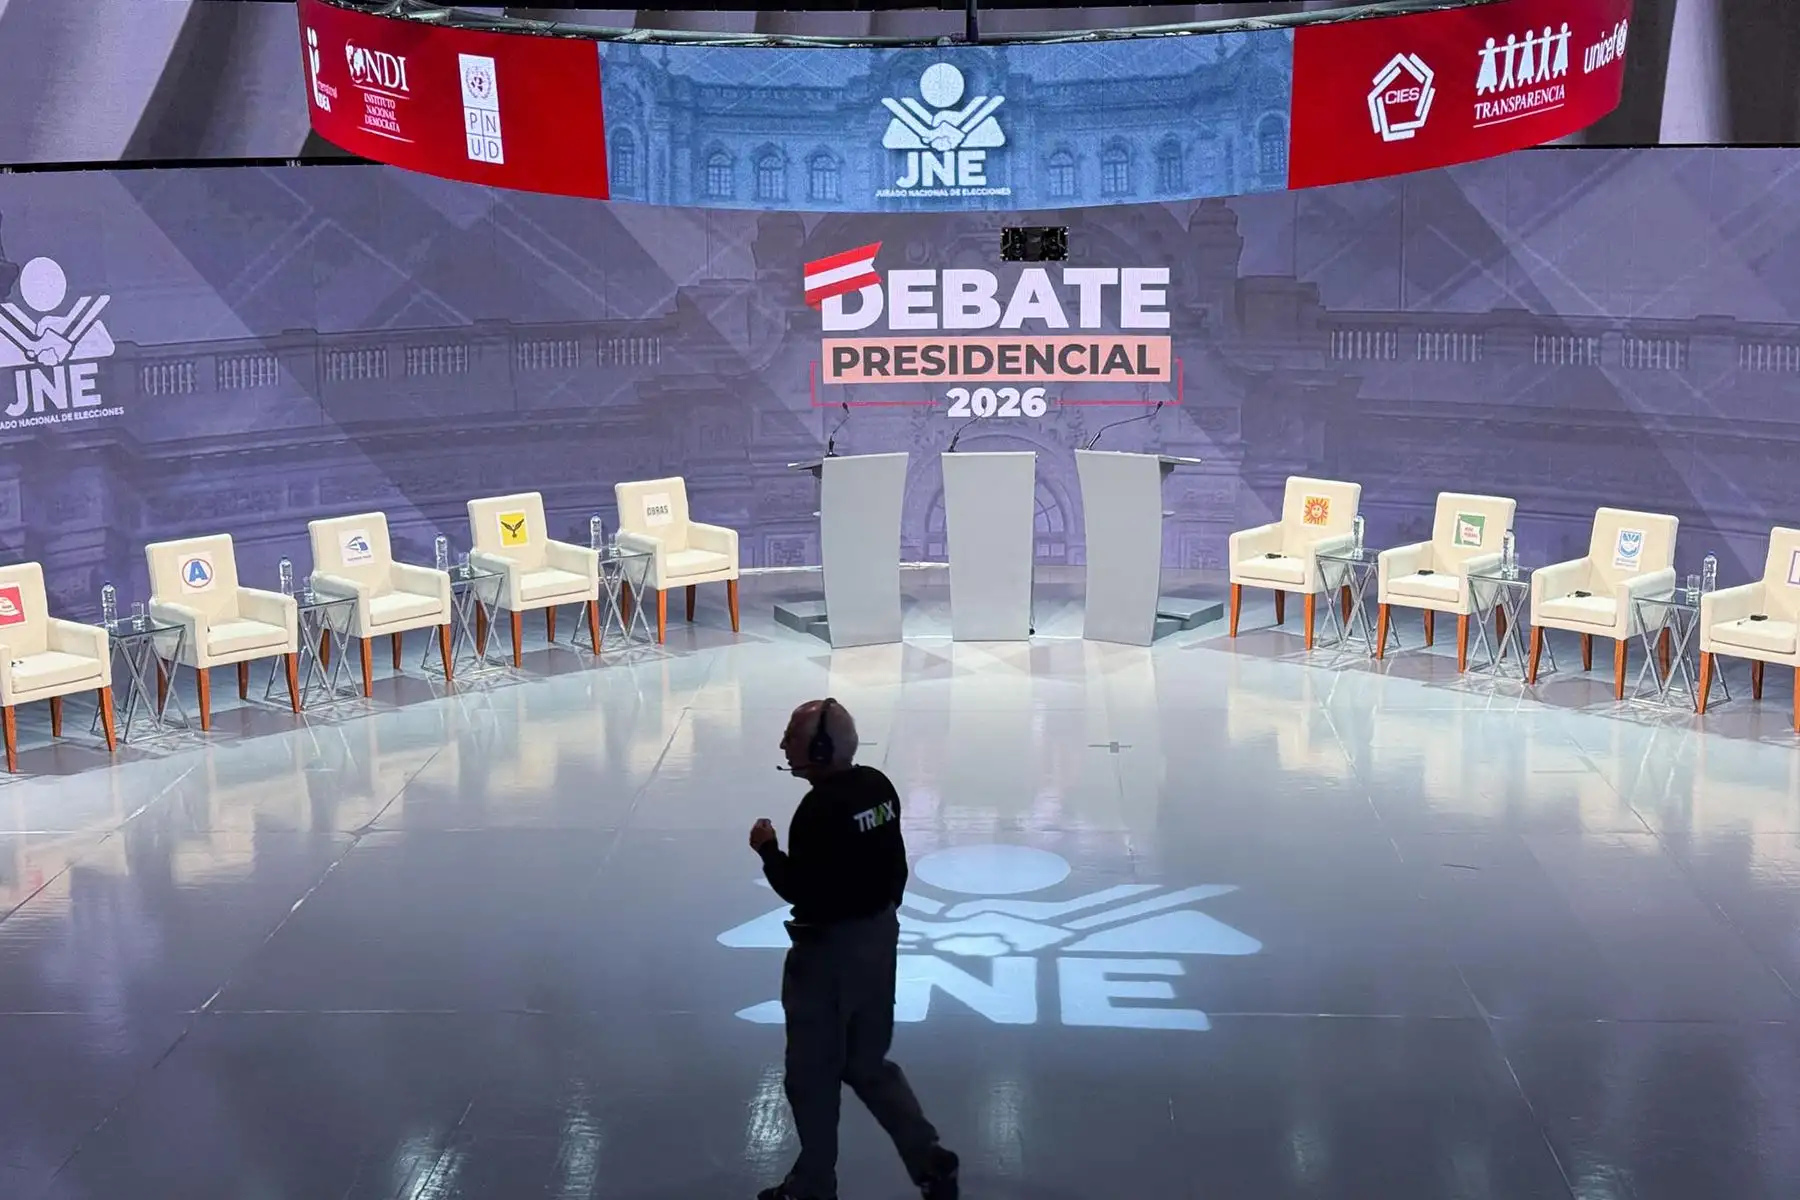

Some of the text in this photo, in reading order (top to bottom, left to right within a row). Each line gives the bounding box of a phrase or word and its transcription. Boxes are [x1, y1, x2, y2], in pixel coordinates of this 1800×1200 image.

[1584, 22, 1618, 74] unicef
[363, 48, 410, 92] NDI
[1385, 87, 1420, 105] CIES
[1474, 84, 1565, 120] TRANSPARENCIA
[896, 150, 987, 188] JNE
[950, 188, 961, 197] DE
[820, 267, 1171, 331] DEBATE
[832, 343, 1161, 377] PRESIDENCIAL
[4, 362, 102, 417] JNE
[946, 386, 1048, 418] 2026
[19, 414, 60, 427] NACIONAL
[61, 412, 73, 422] DE
[74, 406, 125, 420] ELECCIONES
[646, 505, 669, 516] OBRAS
